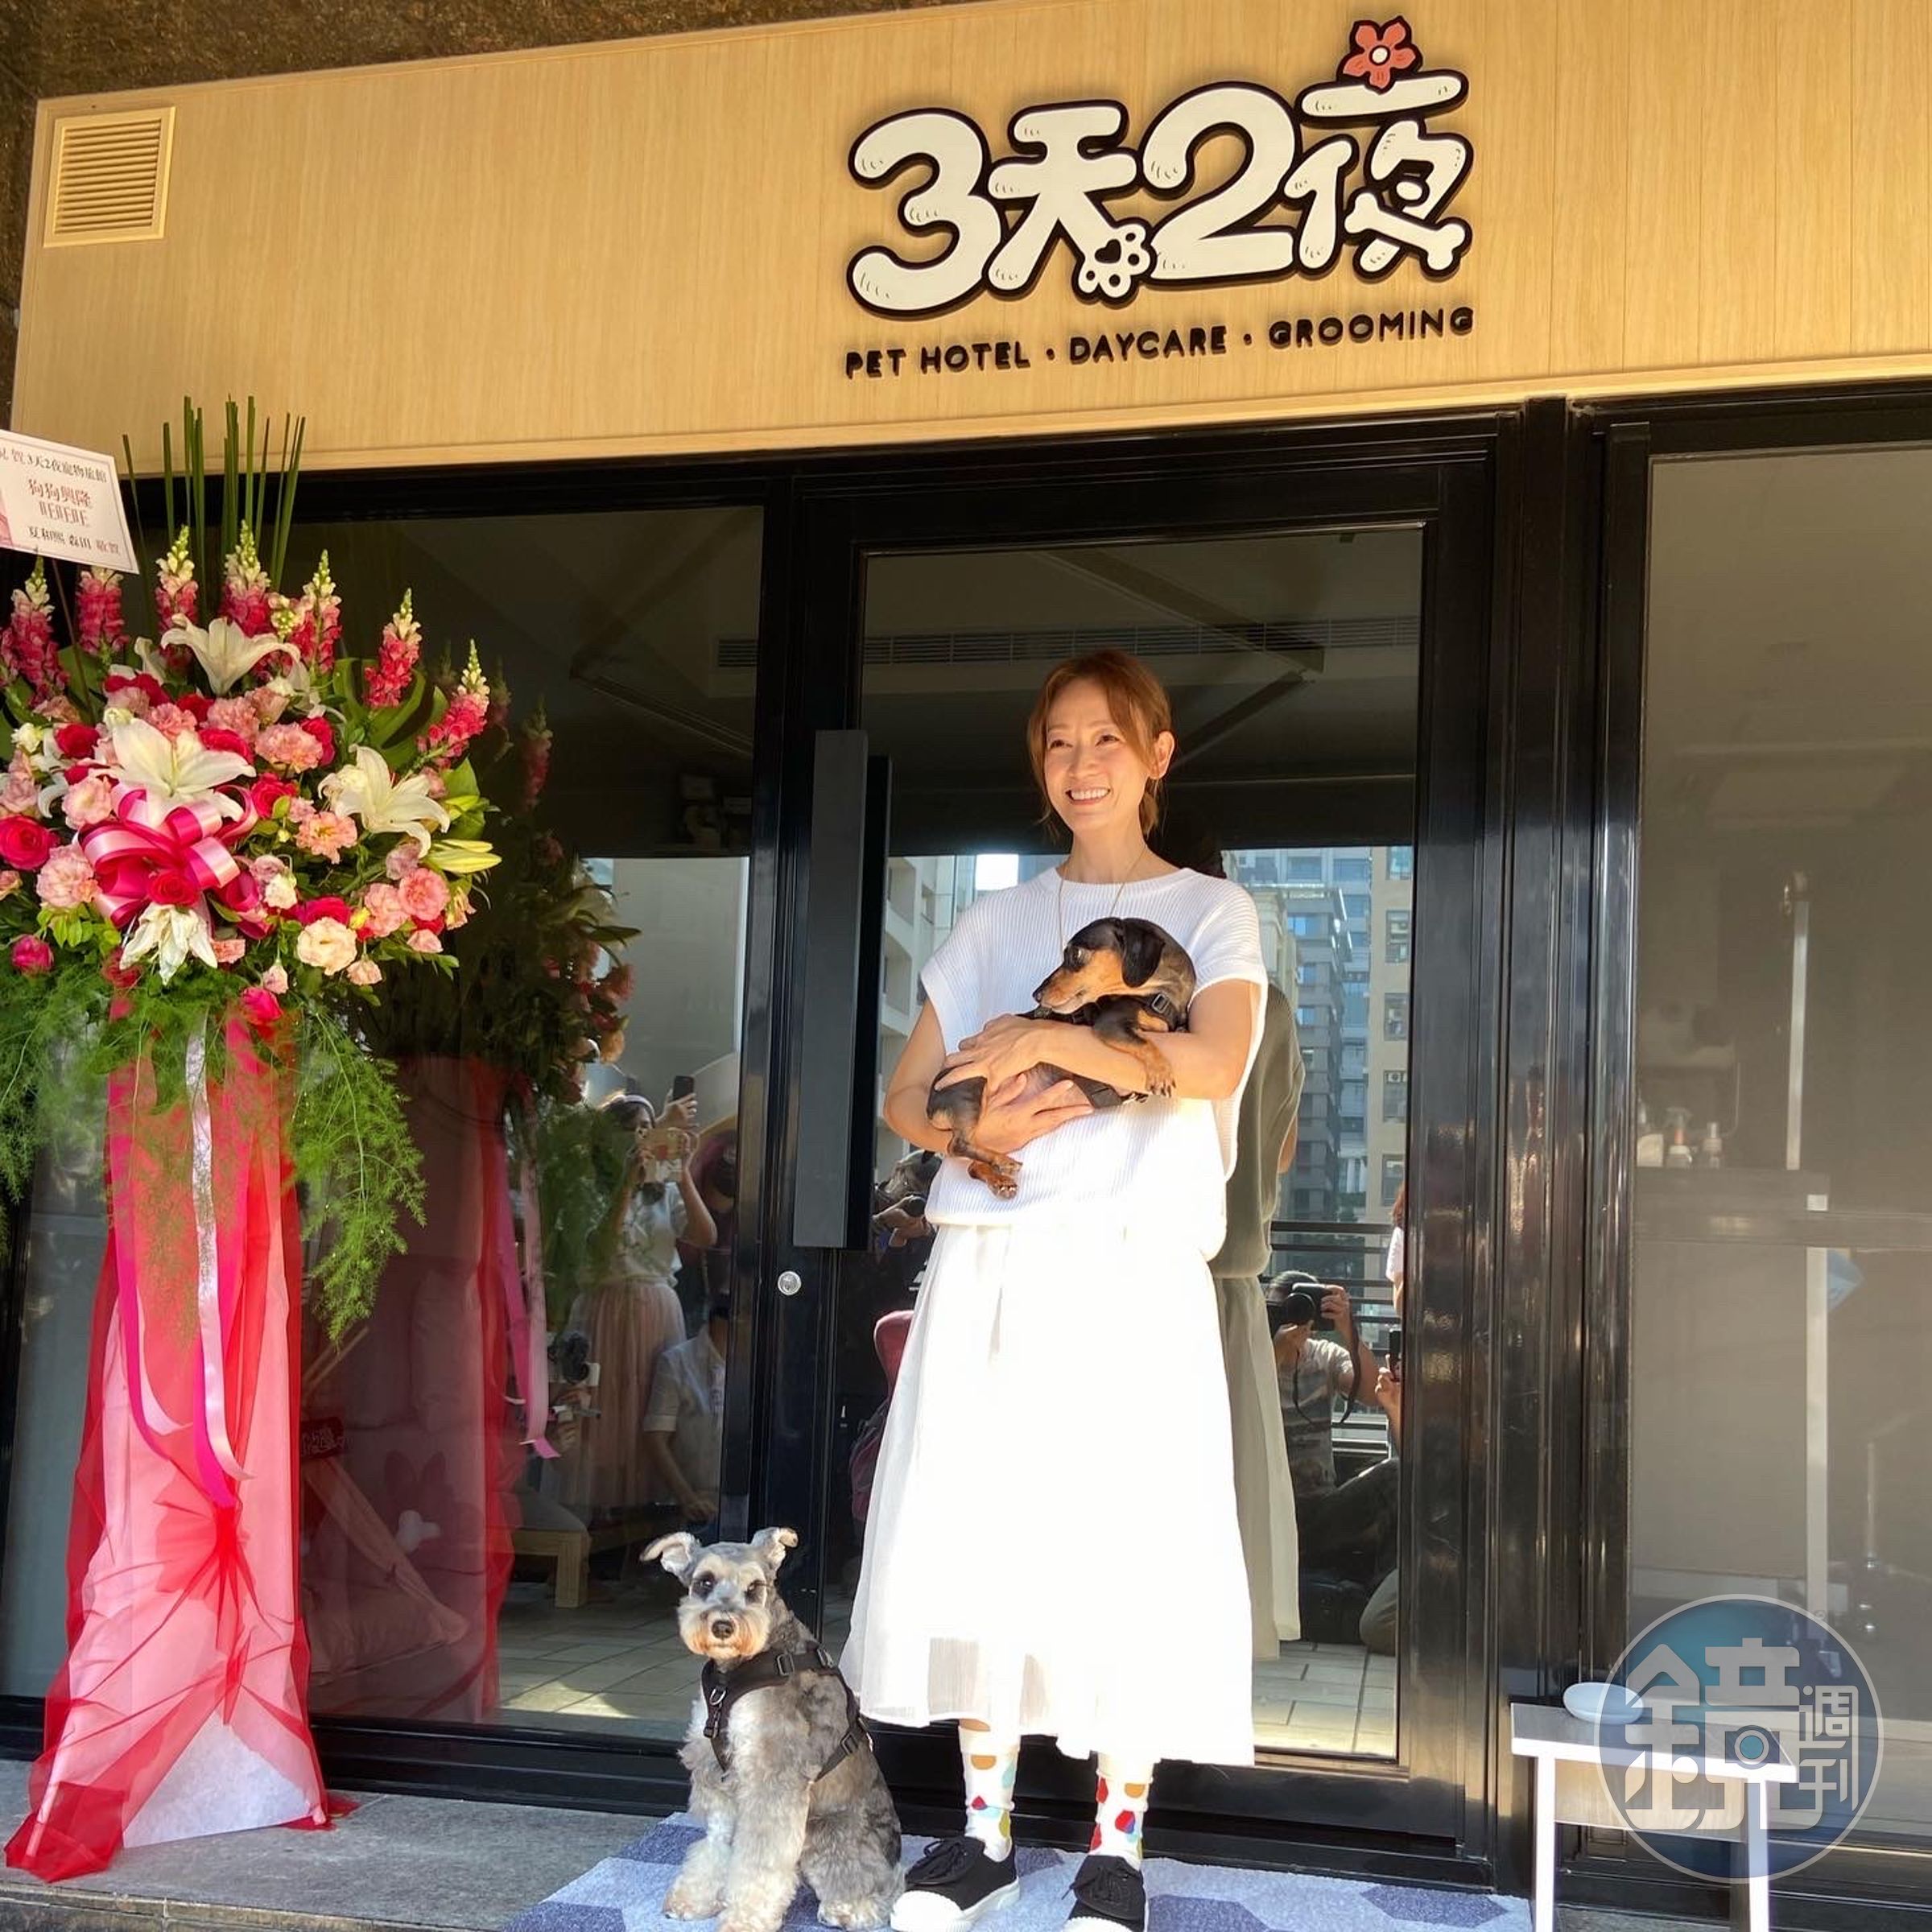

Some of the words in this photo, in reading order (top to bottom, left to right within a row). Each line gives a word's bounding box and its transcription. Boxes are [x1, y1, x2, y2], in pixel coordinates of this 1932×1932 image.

[848, 16, 1474, 316] 3天2夜
[845, 348, 906, 379] PET
[921, 341, 1030, 375] HOTEL
[1069, 325, 1227, 365] DAYCARE
[1269, 307, 1474, 349] GROOMING
